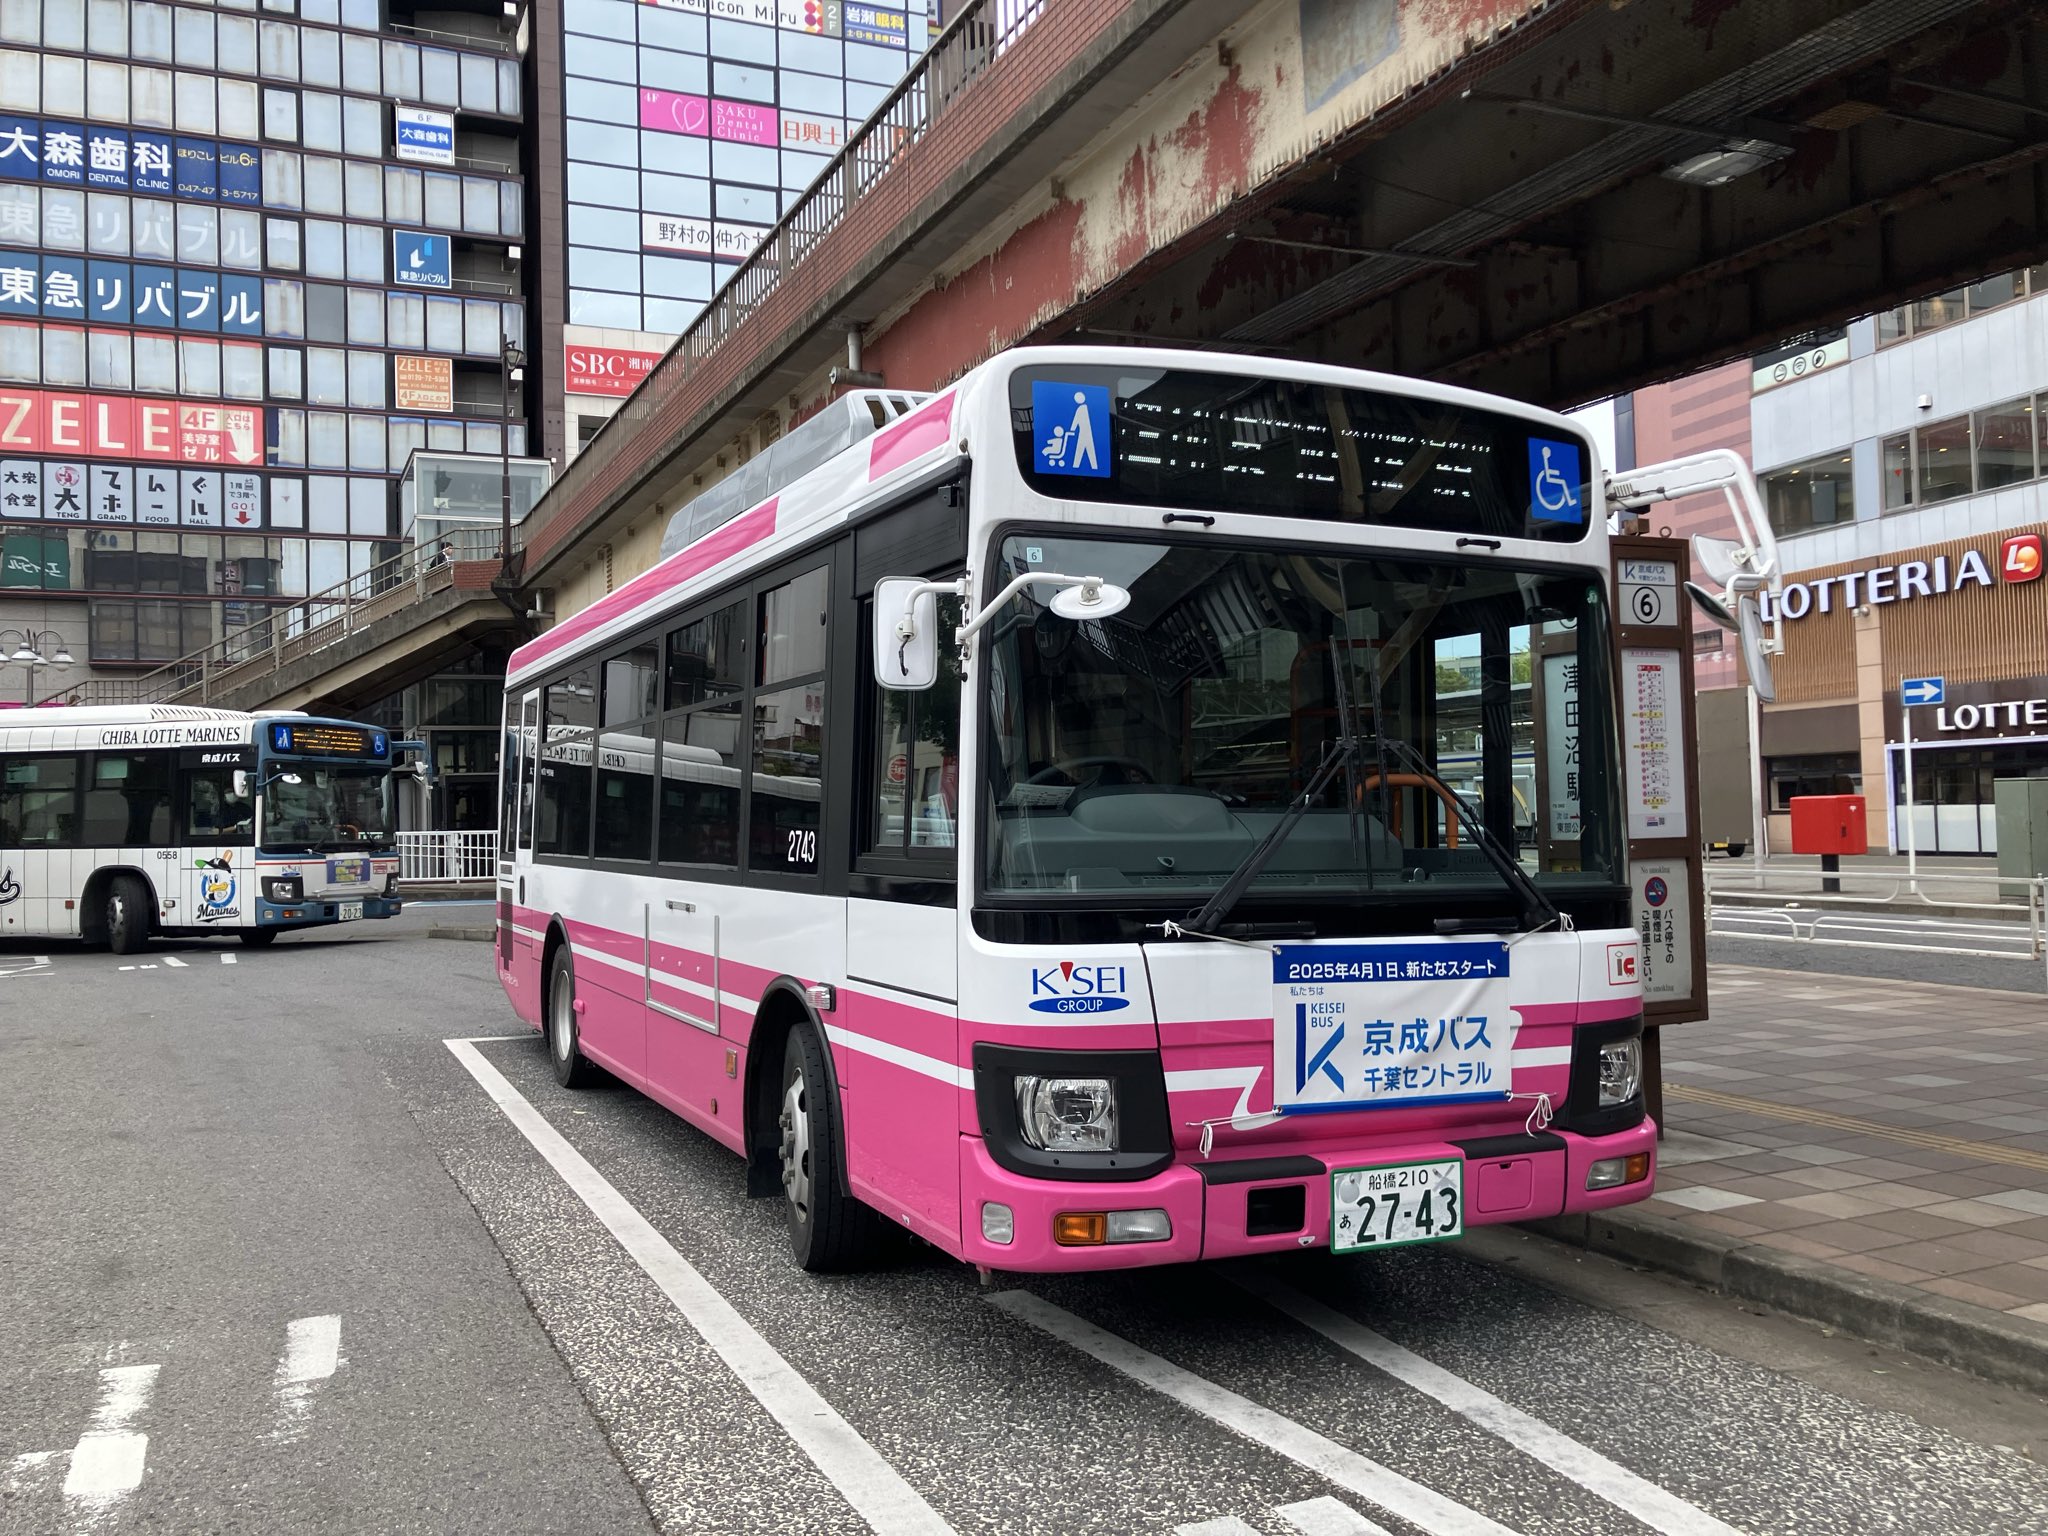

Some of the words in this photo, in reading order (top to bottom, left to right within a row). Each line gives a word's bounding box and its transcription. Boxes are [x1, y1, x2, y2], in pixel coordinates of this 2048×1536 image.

[671, 0, 744, 16] enicon
[755, 6, 797, 25] Miru
[717, 103, 757, 120] SAKU
[717, 115, 763, 132] Dental
[717, 126, 760, 142] Clinic
[783, 120, 856, 147] 日興土
[0, 127, 172, 178] 大森歯科
[47, 168, 80, 179] OMORI
[88, 172, 128, 186] DENTAL
[136, 178, 169, 190] CLINIC
[0, 200, 258, 260] 東急リバブル
[0, 266, 260, 325] 東急リバブル
[399, 358, 432, 373] ZELE
[570, 351, 624, 377] SBC
[629, 357, 660, 371] 湘南
[400, 390, 416, 400] 4F
[2, 397, 170, 452] ZELE
[184, 410, 216, 428] 4F
[182, 432, 221, 446] 美容室
[182, 446, 220, 460] ゼル
[4, 471, 38, 485] 大衆
[4, 492, 37, 508] 食堂
[56, 511, 80, 519] TENG
[97, 513, 128, 521] GRAND
[145, 515, 170, 523] FOOD
[1761, 550, 1993, 623] LOTTERIA
[102, 730, 138, 745] CHIBA
[143, 728, 182, 744] LOTTE
[185, 726, 241, 742] MARINES
[201, 753, 241, 763] 京成バス
[156, 850, 178, 860] 0558
[788, 830, 816, 863] 2743
[1652, 909, 1663, 944] 喫煙は
[1664, 908, 1675, 964] バス停での
[1289, 958, 1497, 980] 2025年4月1日、新たなスタート
[1290, 986, 1324, 997] 私たちは
[1057, 999, 1103, 1013] GROUP
[1311, 1002, 1345, 1014] KEISEI
[1311, 1016, 1333, 1028] BUS
[1363, 1016, 1492, 1056] 京成バス
[1363, 1061, 1492, 1093] 千葉セントラル
[1339, 1213, 1352, 1230] あ
[1356, 1187, 1458, 1244] 27-43
